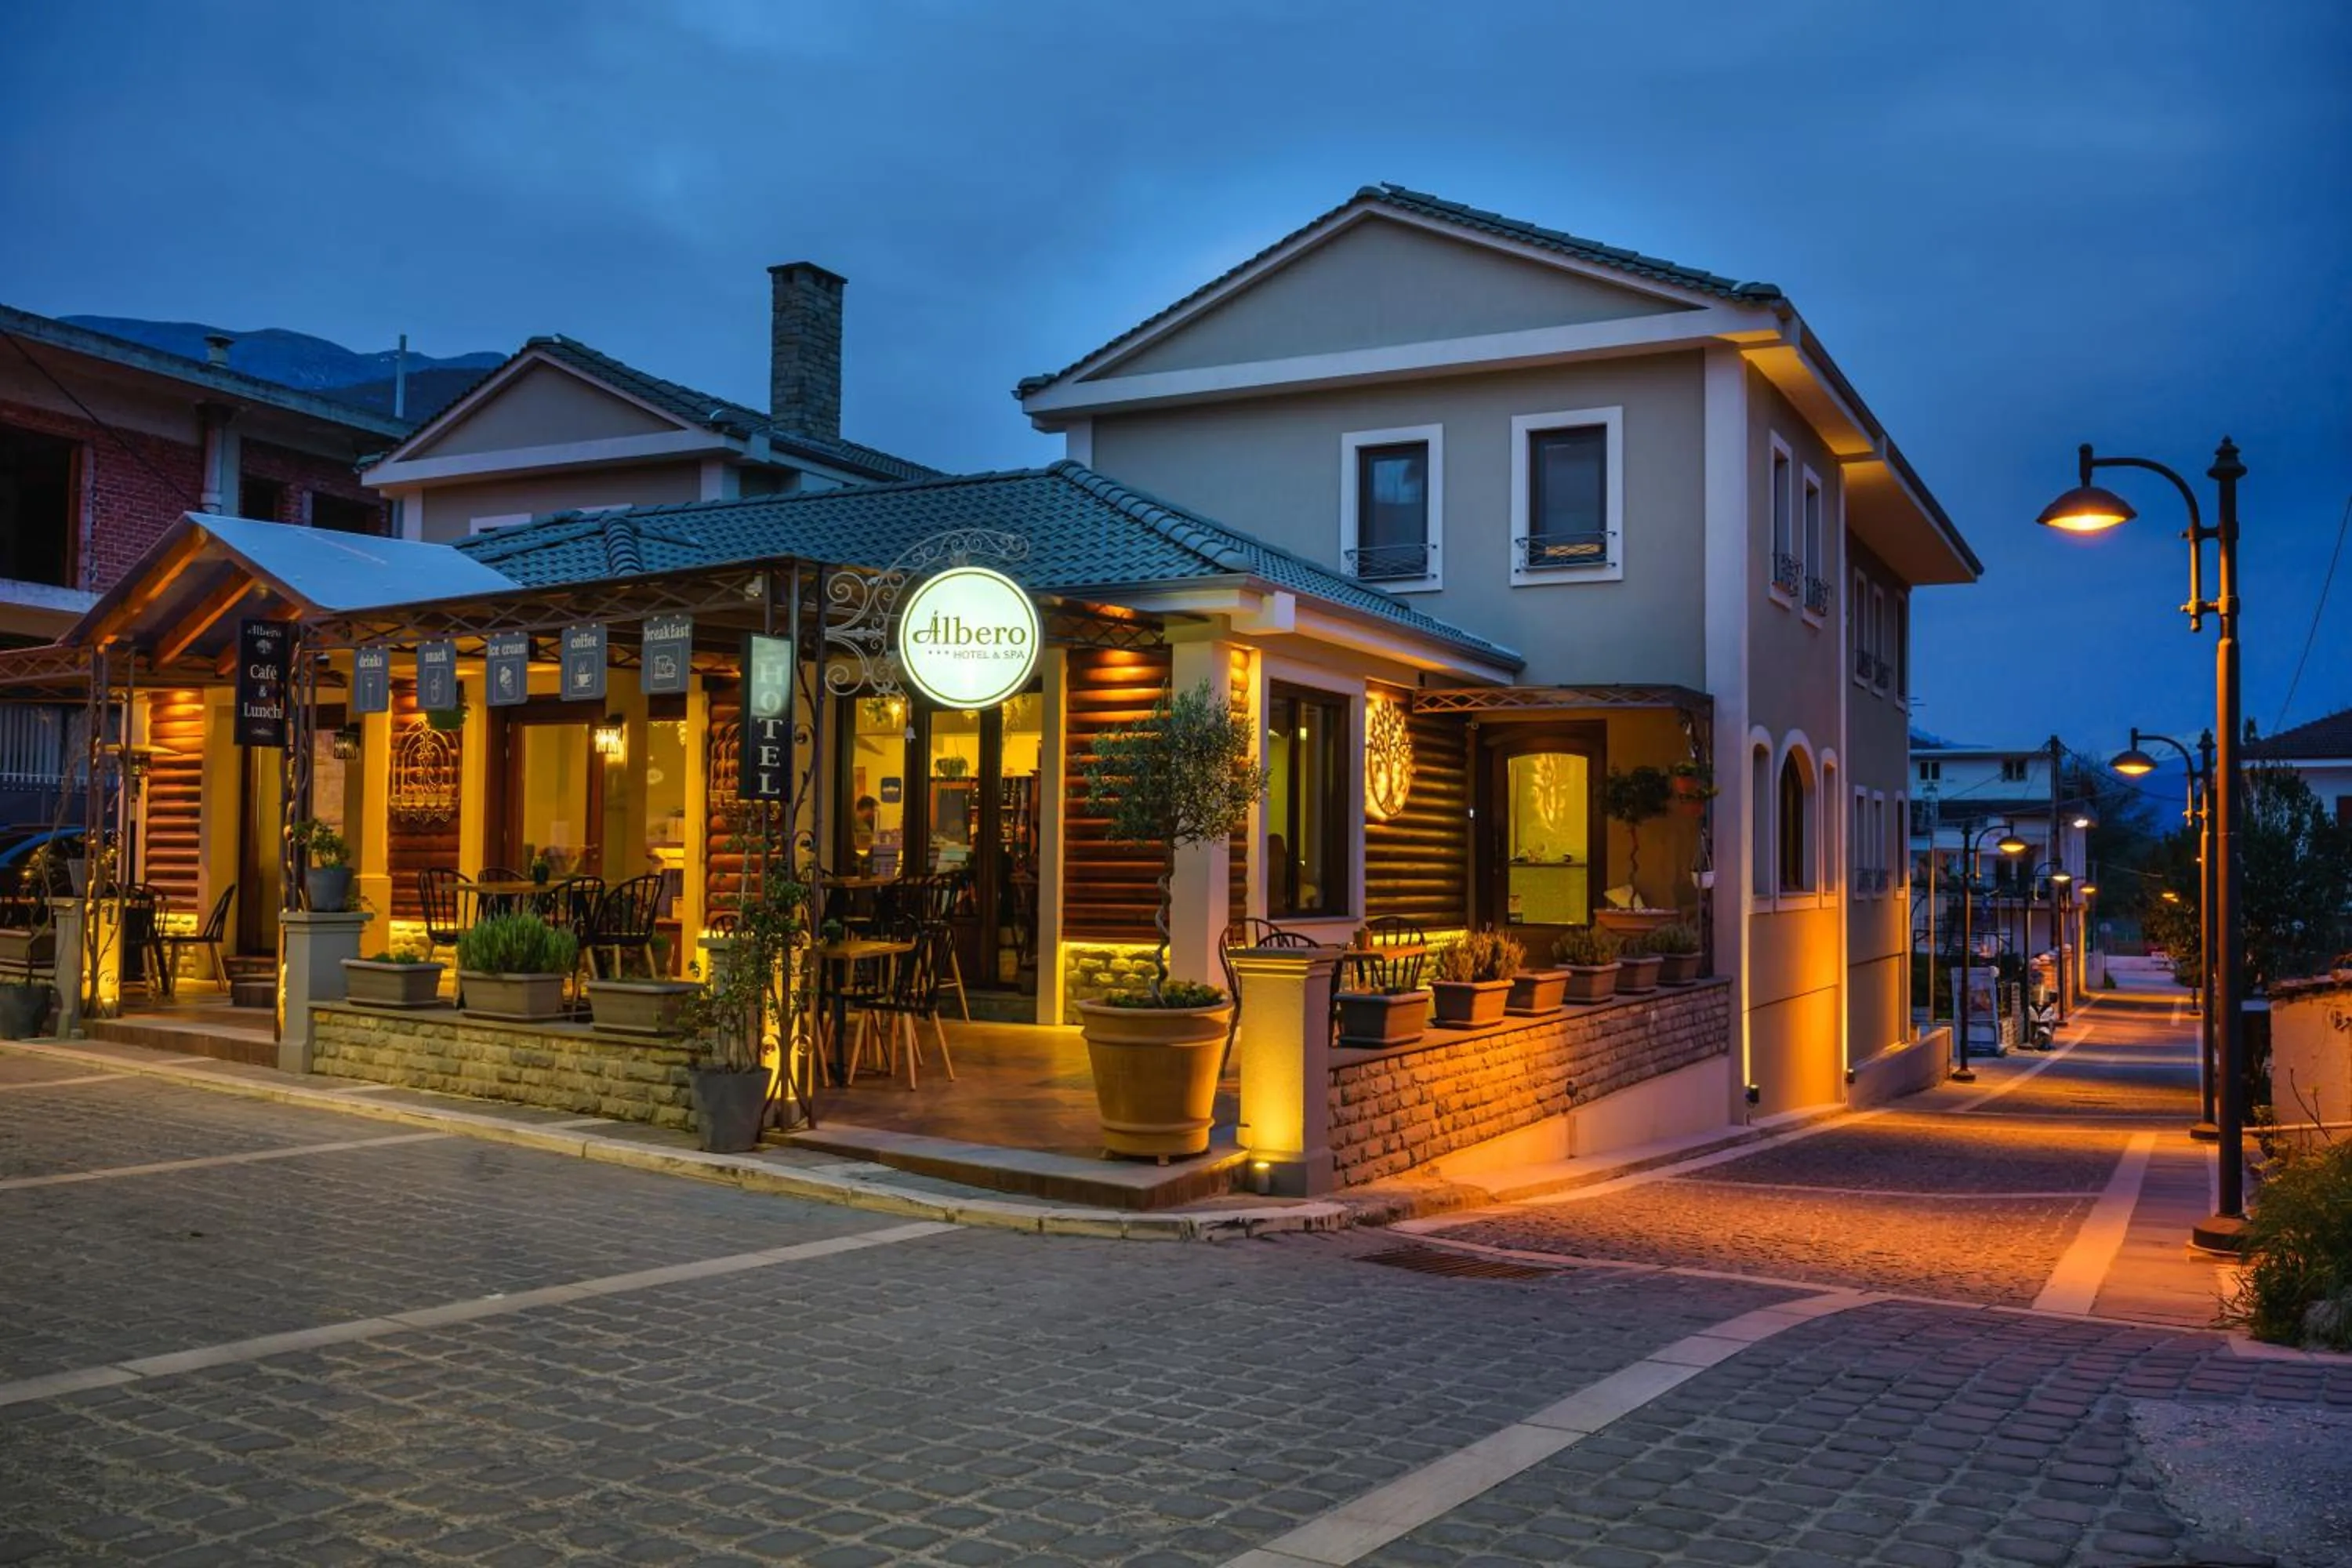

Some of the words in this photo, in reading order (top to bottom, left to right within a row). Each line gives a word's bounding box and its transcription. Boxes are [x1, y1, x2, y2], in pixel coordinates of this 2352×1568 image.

[644, 623, 689, 641] breakfast
[571, 633, 597, 649] coffee
[425, 648, 447, 662] snack
[488, 642, 499, 656] ice
[502, 643, 526, 655] cream
[953, 650, 989, 659] HOTEL
[992, 650, 1001, 659] &
[1003, 650, 1025, 659] SPA
[358, 654, 383, 668] drinks
[250, 664, 277, 680] Café
[259, 684, 267, 698] &
[244, 702, 283, 720] Lunch
[757, 662, 784, 795] HOTEL
